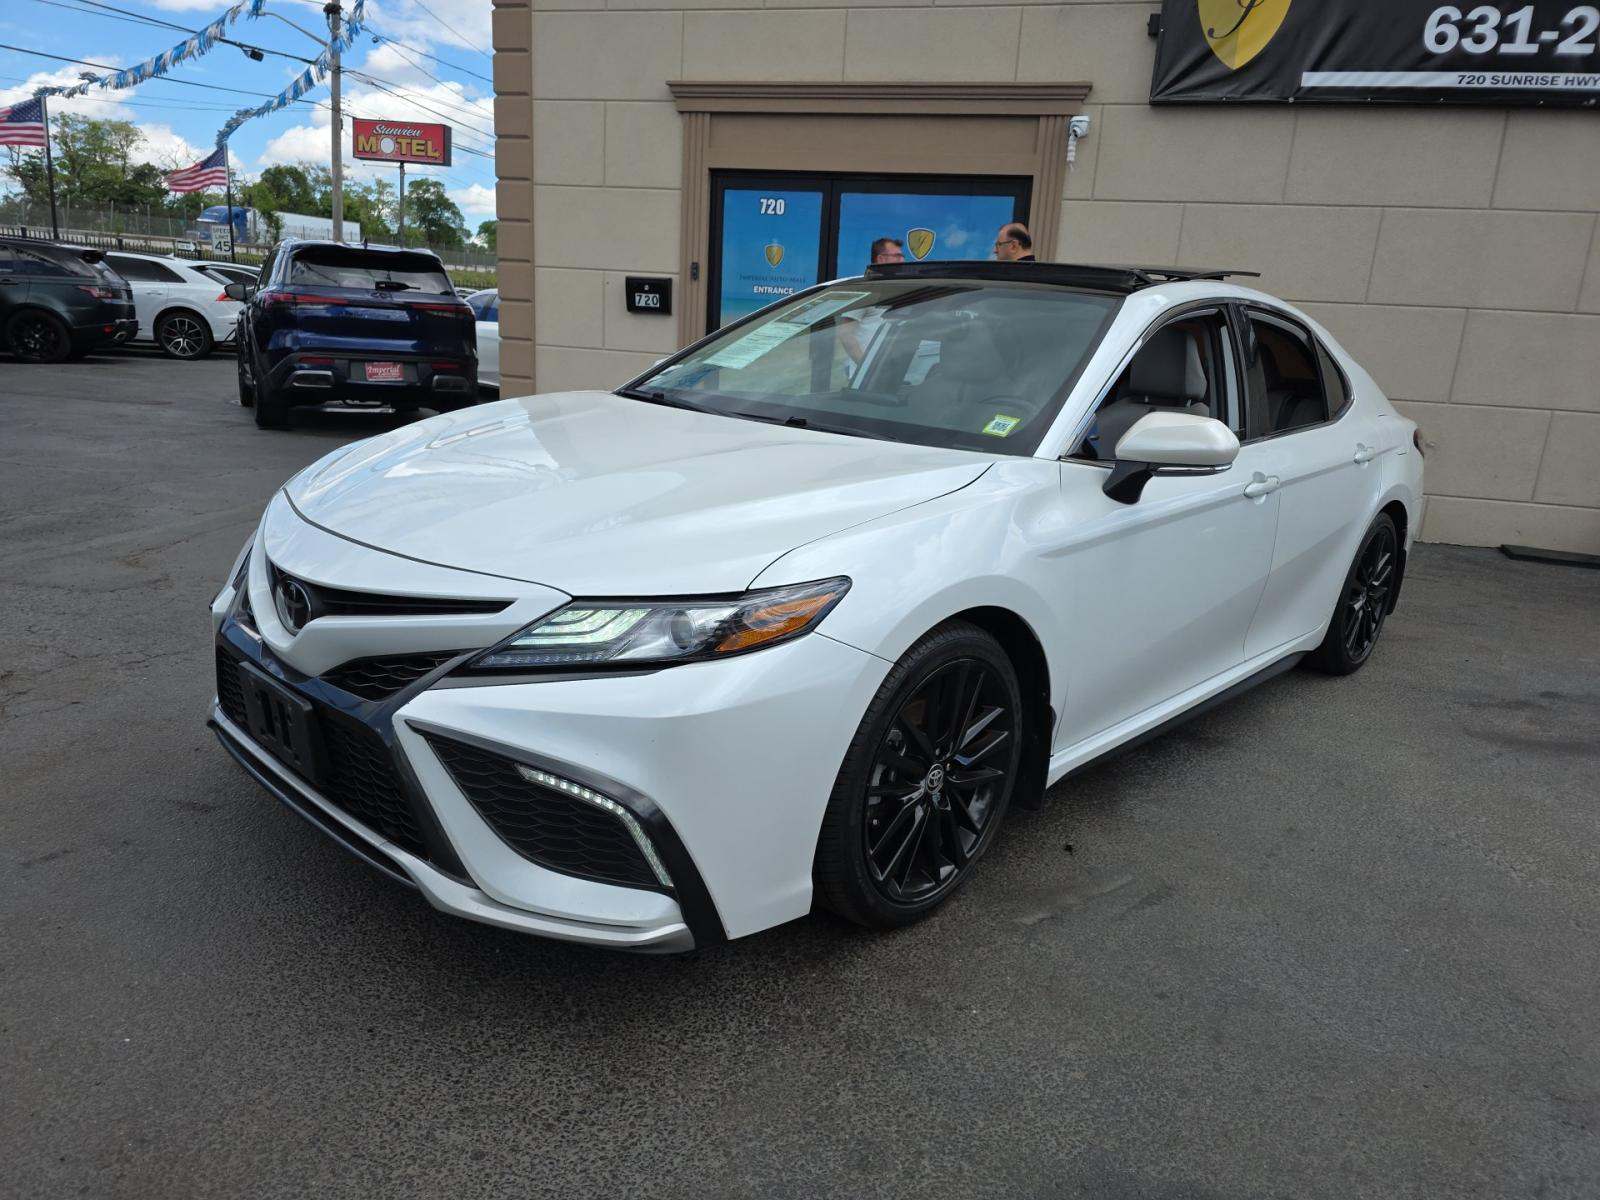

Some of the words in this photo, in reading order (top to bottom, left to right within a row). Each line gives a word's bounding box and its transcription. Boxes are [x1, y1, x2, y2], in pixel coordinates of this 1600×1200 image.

[1424, 5, 1600, 54] 631-2
[1457, 74, 1486, 86] 720
[1490, 75, 1560, 86] SUNRISE
[1564, 75, 1600, 87] HWY
[373, 123, 423, 137] Sunview
[357, 134, 441, 158] MOTEL
[760, 198, 785, 215] 720
[214, 240, 231, 252] 45
[753, 285, 793, 295] ENTRANCE
[635, 294, 659, 306] 720
